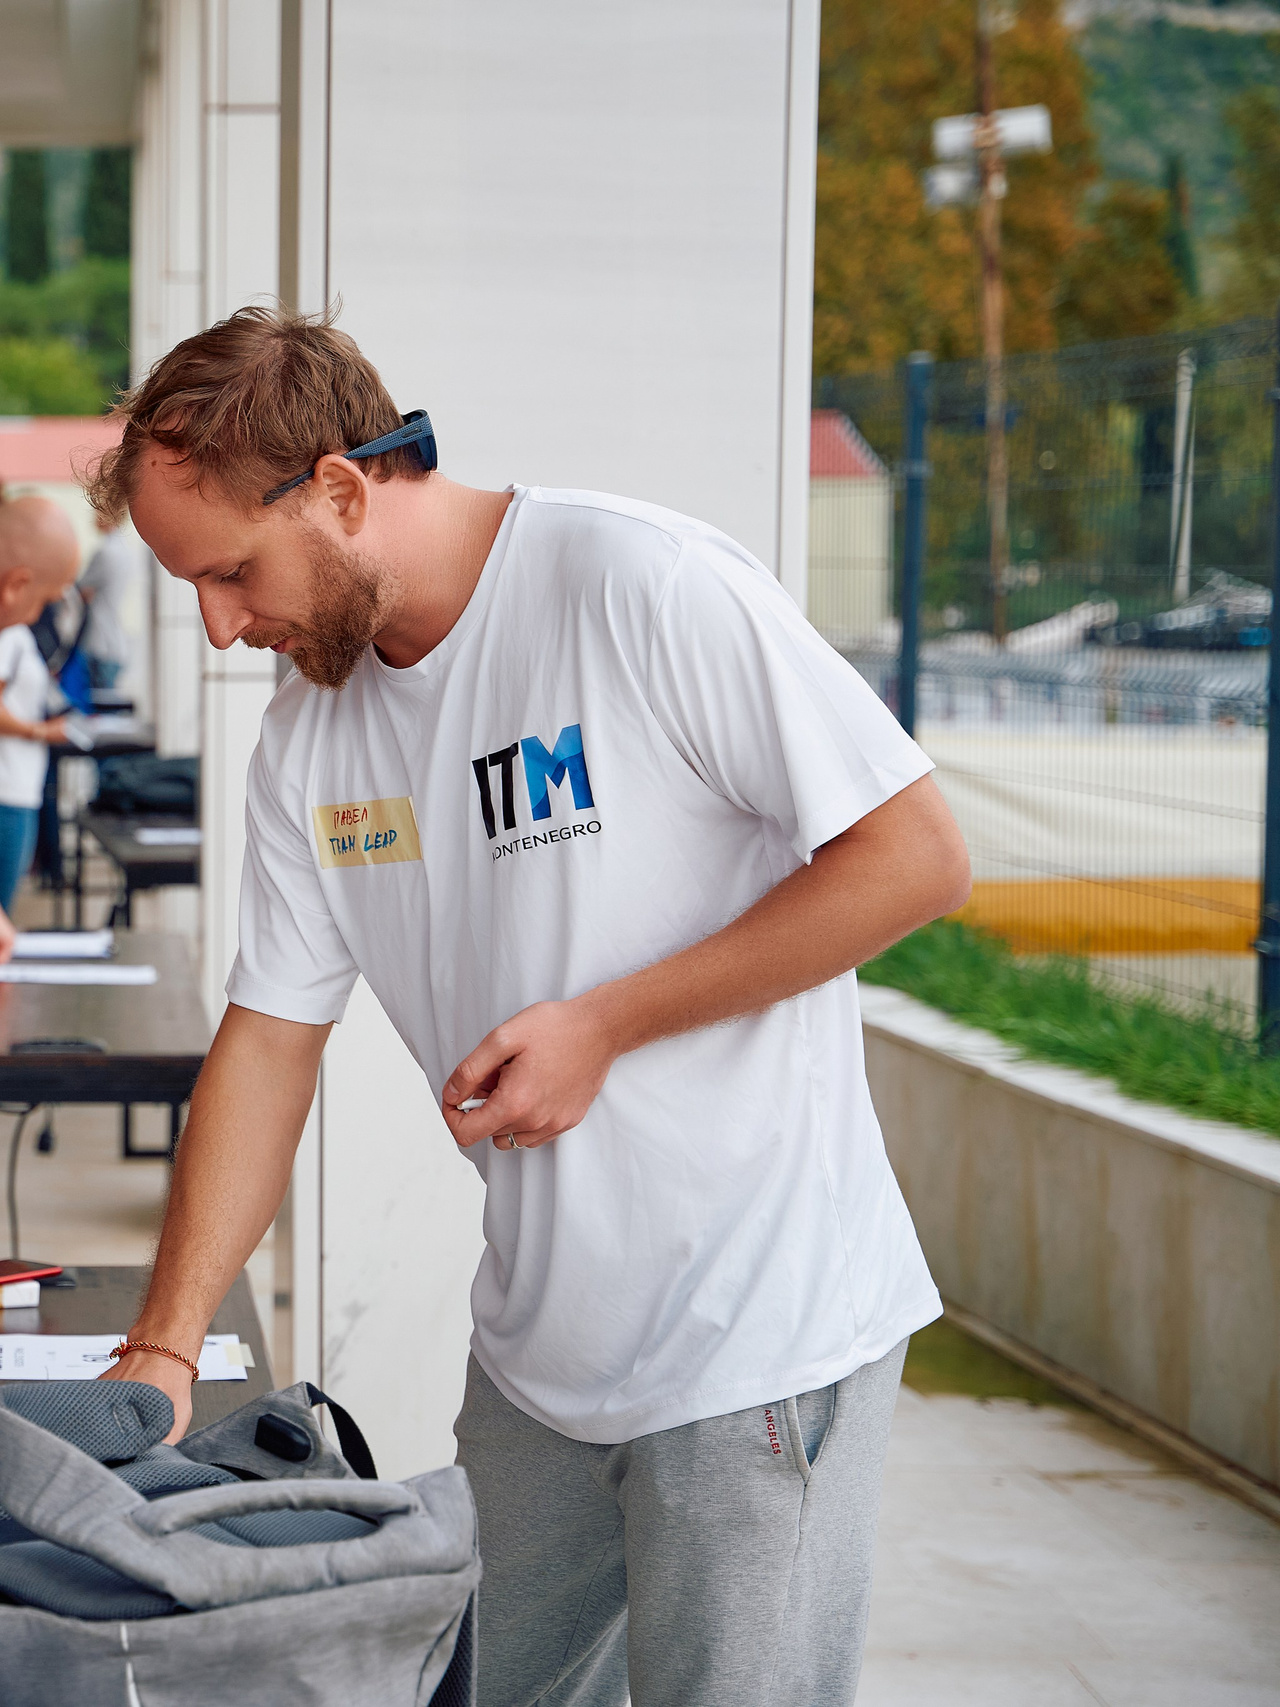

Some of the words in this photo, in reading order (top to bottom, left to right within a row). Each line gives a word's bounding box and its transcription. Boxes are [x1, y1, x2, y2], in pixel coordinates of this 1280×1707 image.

[471, 723, 595, 840] ITM
[333, 806, 368, 829] ПАВЕЛ
[764, 1409, 782, 1455] ANGELES
